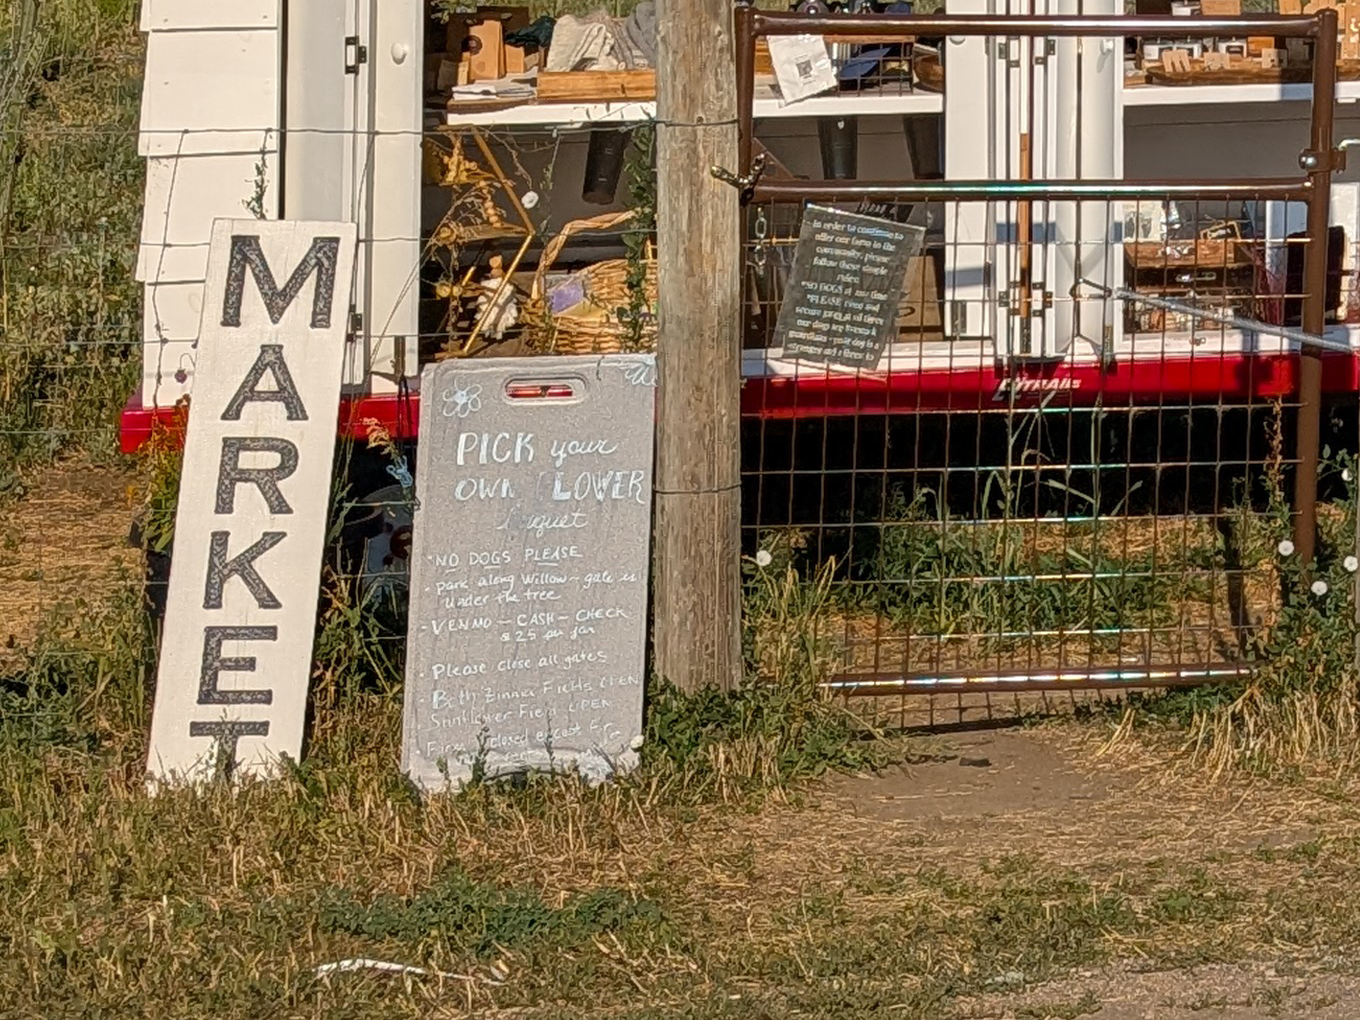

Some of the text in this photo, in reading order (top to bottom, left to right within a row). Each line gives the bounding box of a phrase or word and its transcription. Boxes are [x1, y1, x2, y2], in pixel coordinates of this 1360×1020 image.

[456, 432, 618, 468] PICK your
[537, 470, 646, 504] LOWER
[190, 234, 340, 778] MARKET
[435, 545, 583, 568] NO DOGS PLEASE
[478, 574, 515, 593] along
[523, 588, 562, 601] tree
[431, 607, 629, 635] VENMO CASH CHECK
[432, 663, 487, 679] Please
[538, 657, 559, 668] all
